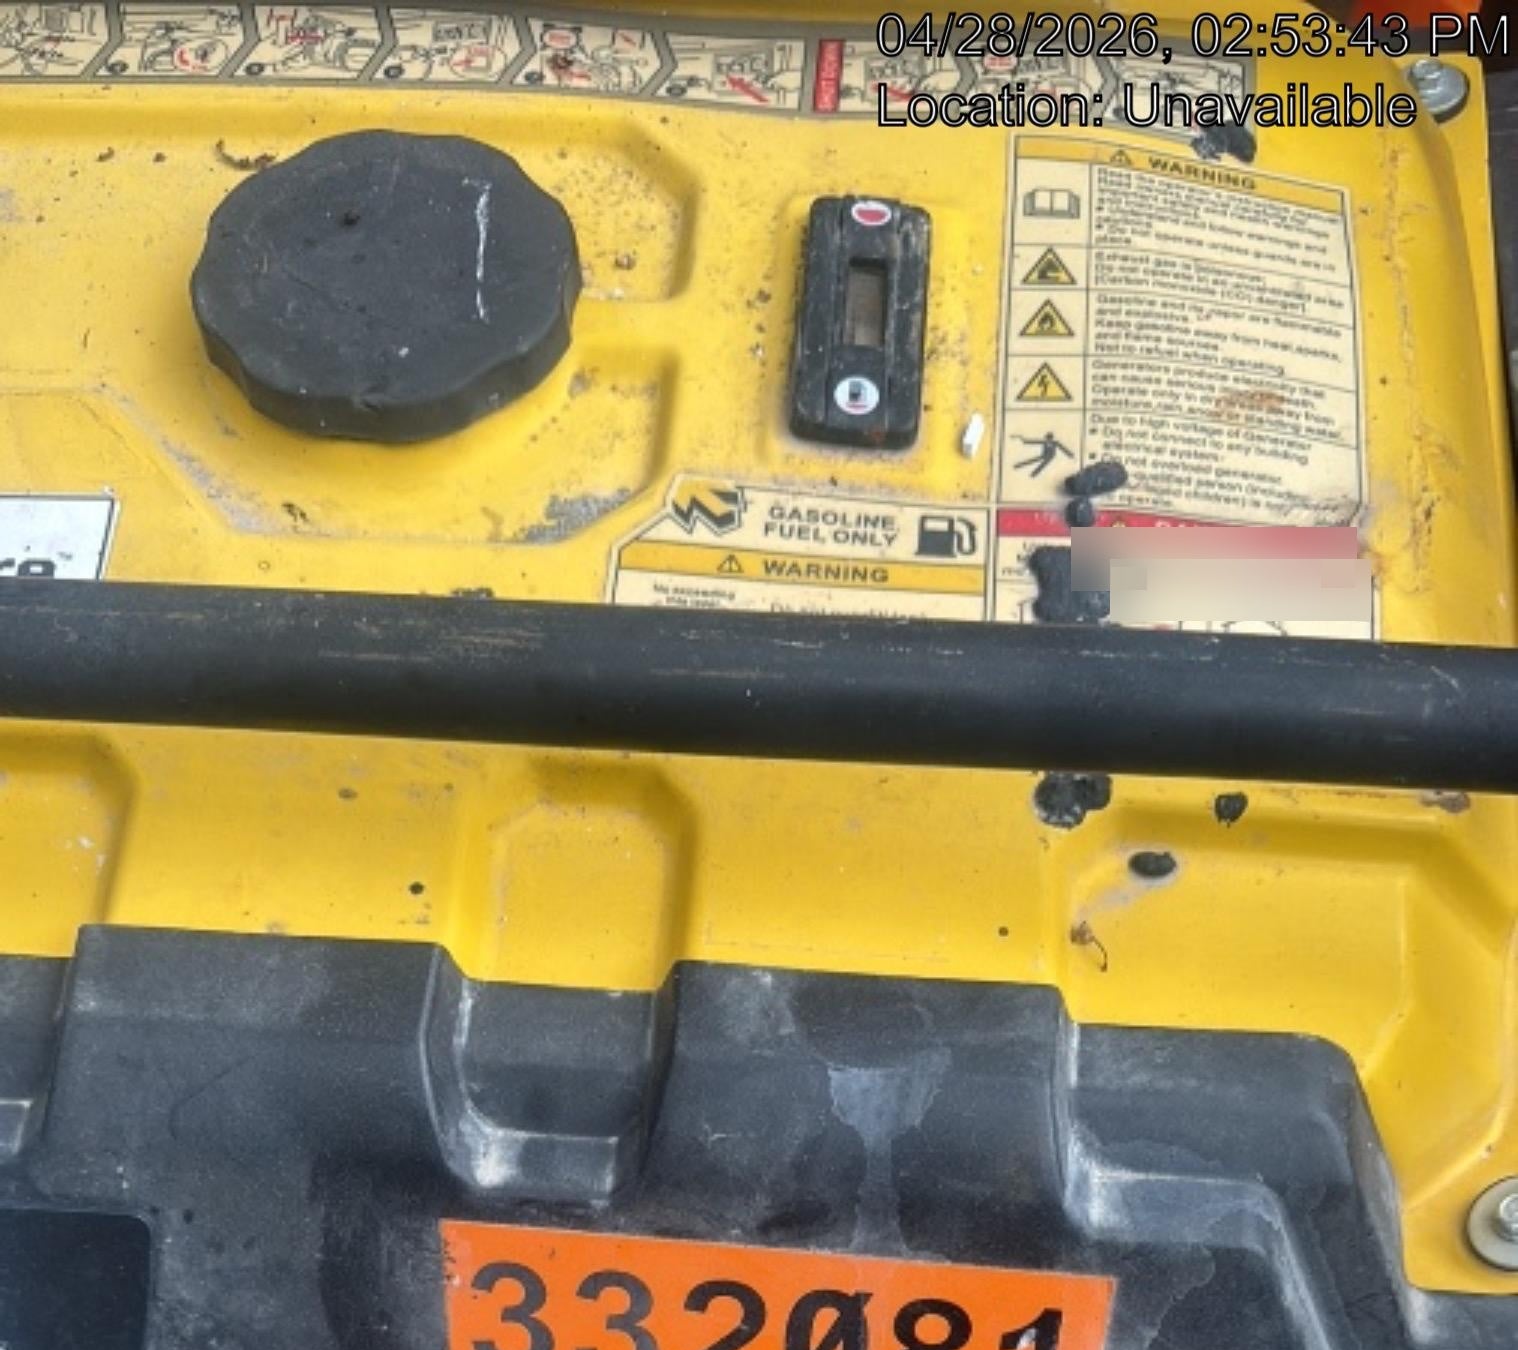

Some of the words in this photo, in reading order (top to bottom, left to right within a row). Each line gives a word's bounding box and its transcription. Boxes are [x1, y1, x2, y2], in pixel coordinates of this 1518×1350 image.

[1148, 156, 1257, 191] WARNING
[768, 504, 896, 532] GASOLINE
[764, 520, 825, 545] FUEL
[833, 529, 897, 547] ONLY
[763, 559, 889, 584] WARNING
